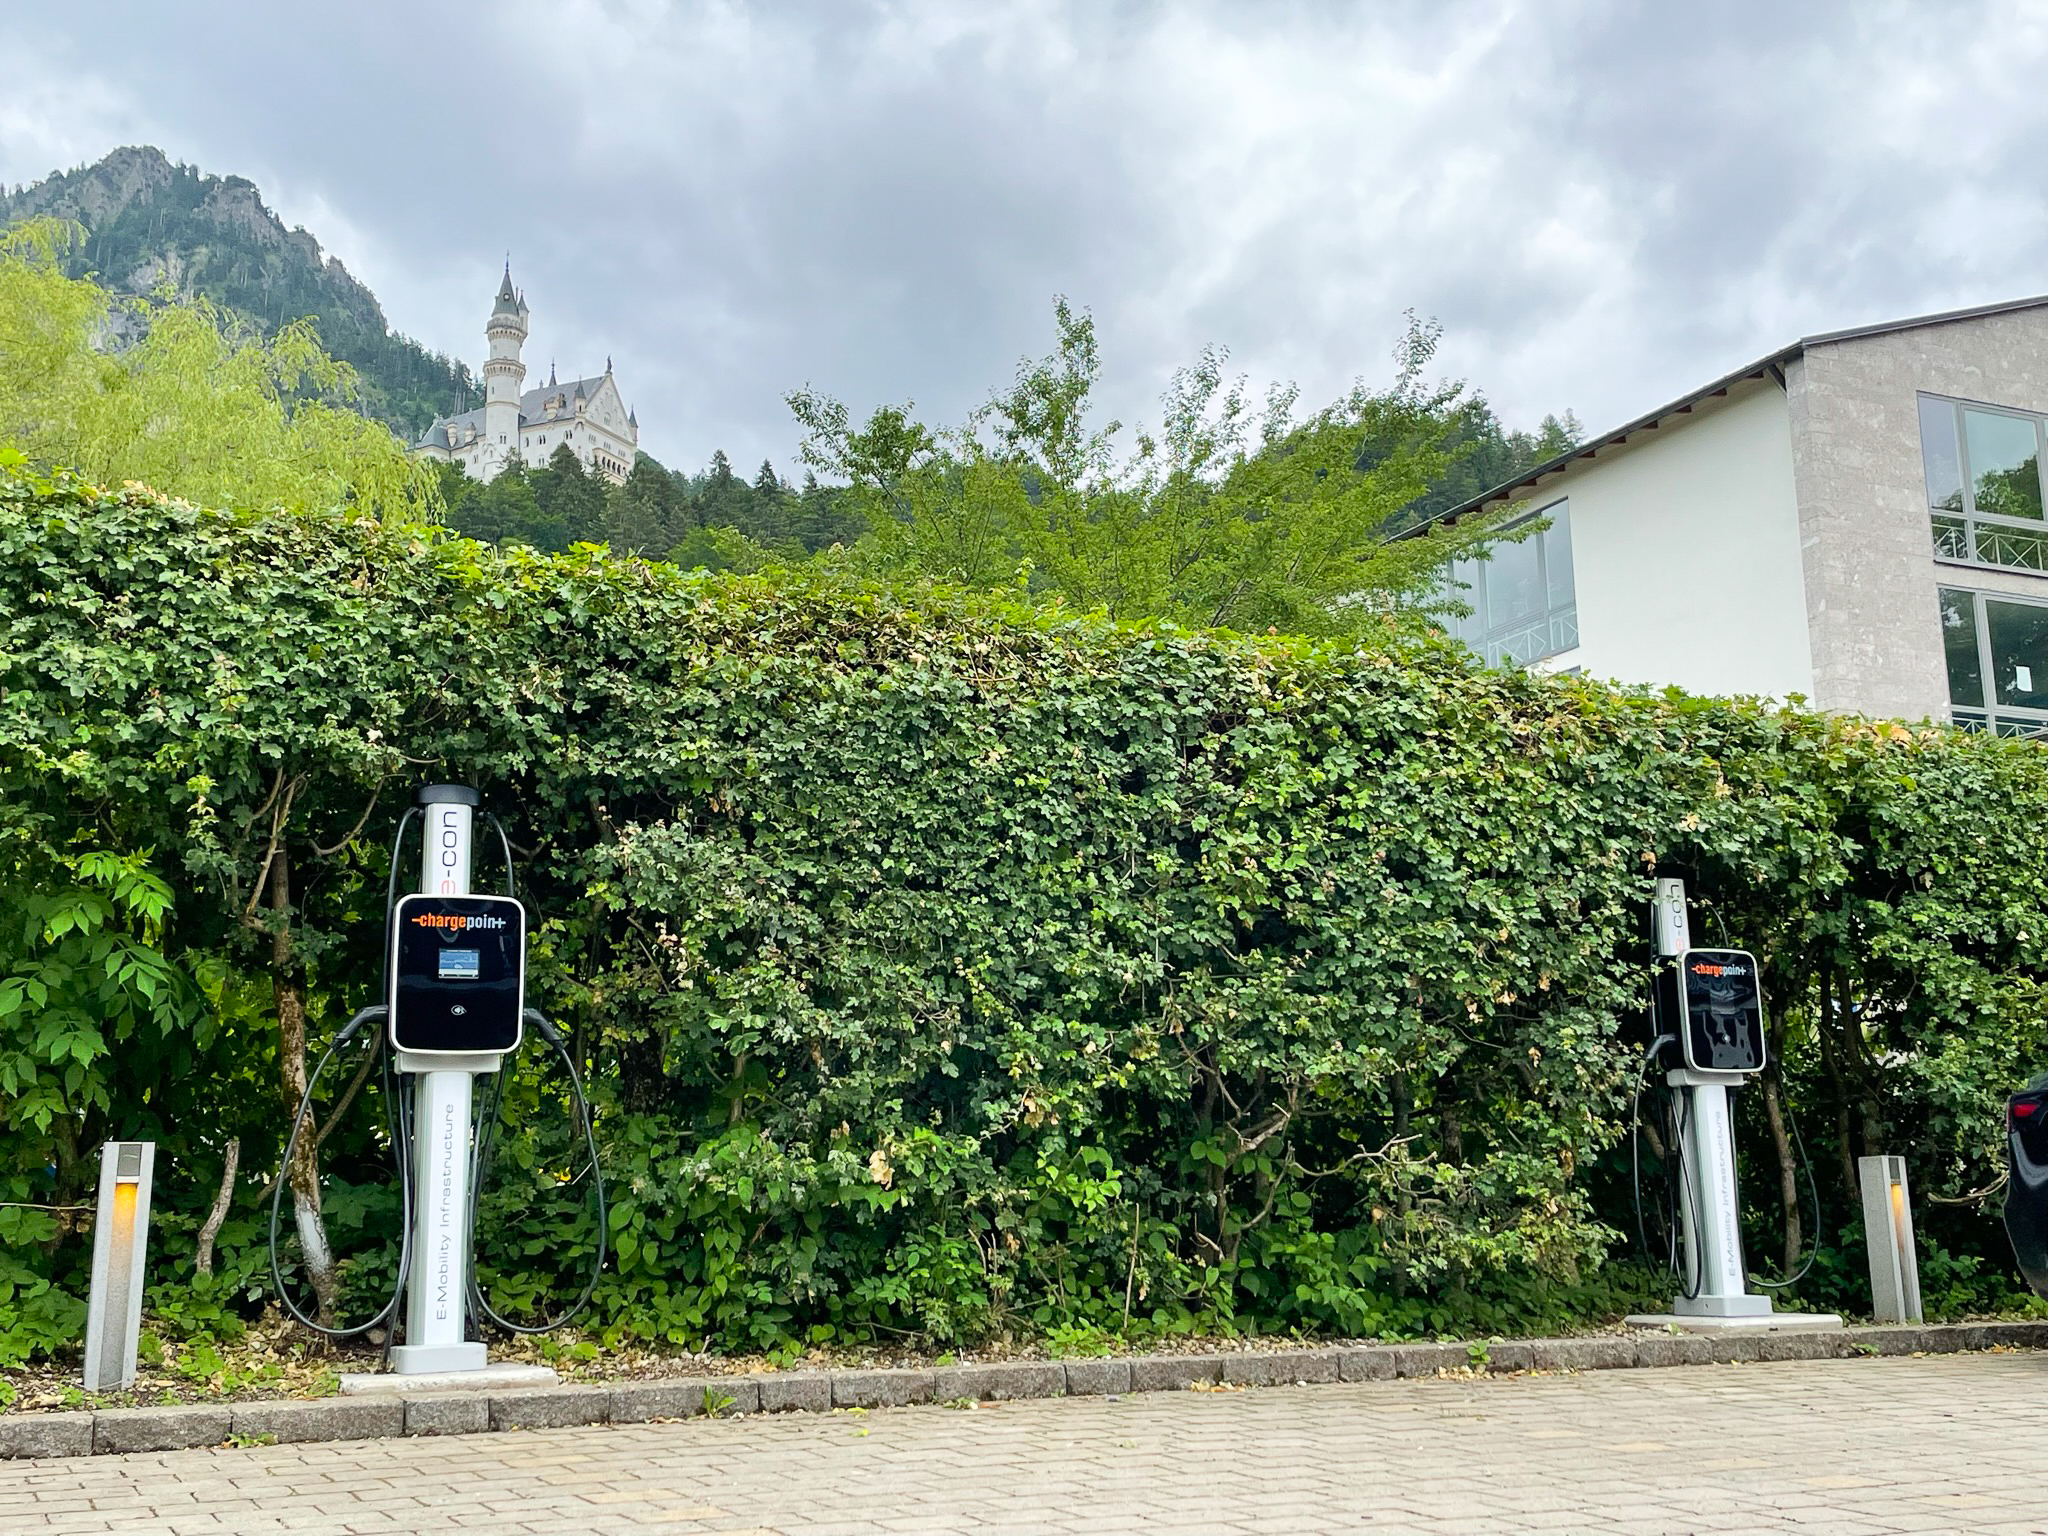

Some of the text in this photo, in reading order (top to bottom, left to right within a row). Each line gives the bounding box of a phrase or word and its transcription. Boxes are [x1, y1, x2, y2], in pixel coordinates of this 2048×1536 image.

[436, 1103, 454, 1320] E-Mobility Infrastructure
[1715, 1111, 1735, 1276] E-Mobility Infrastructure
